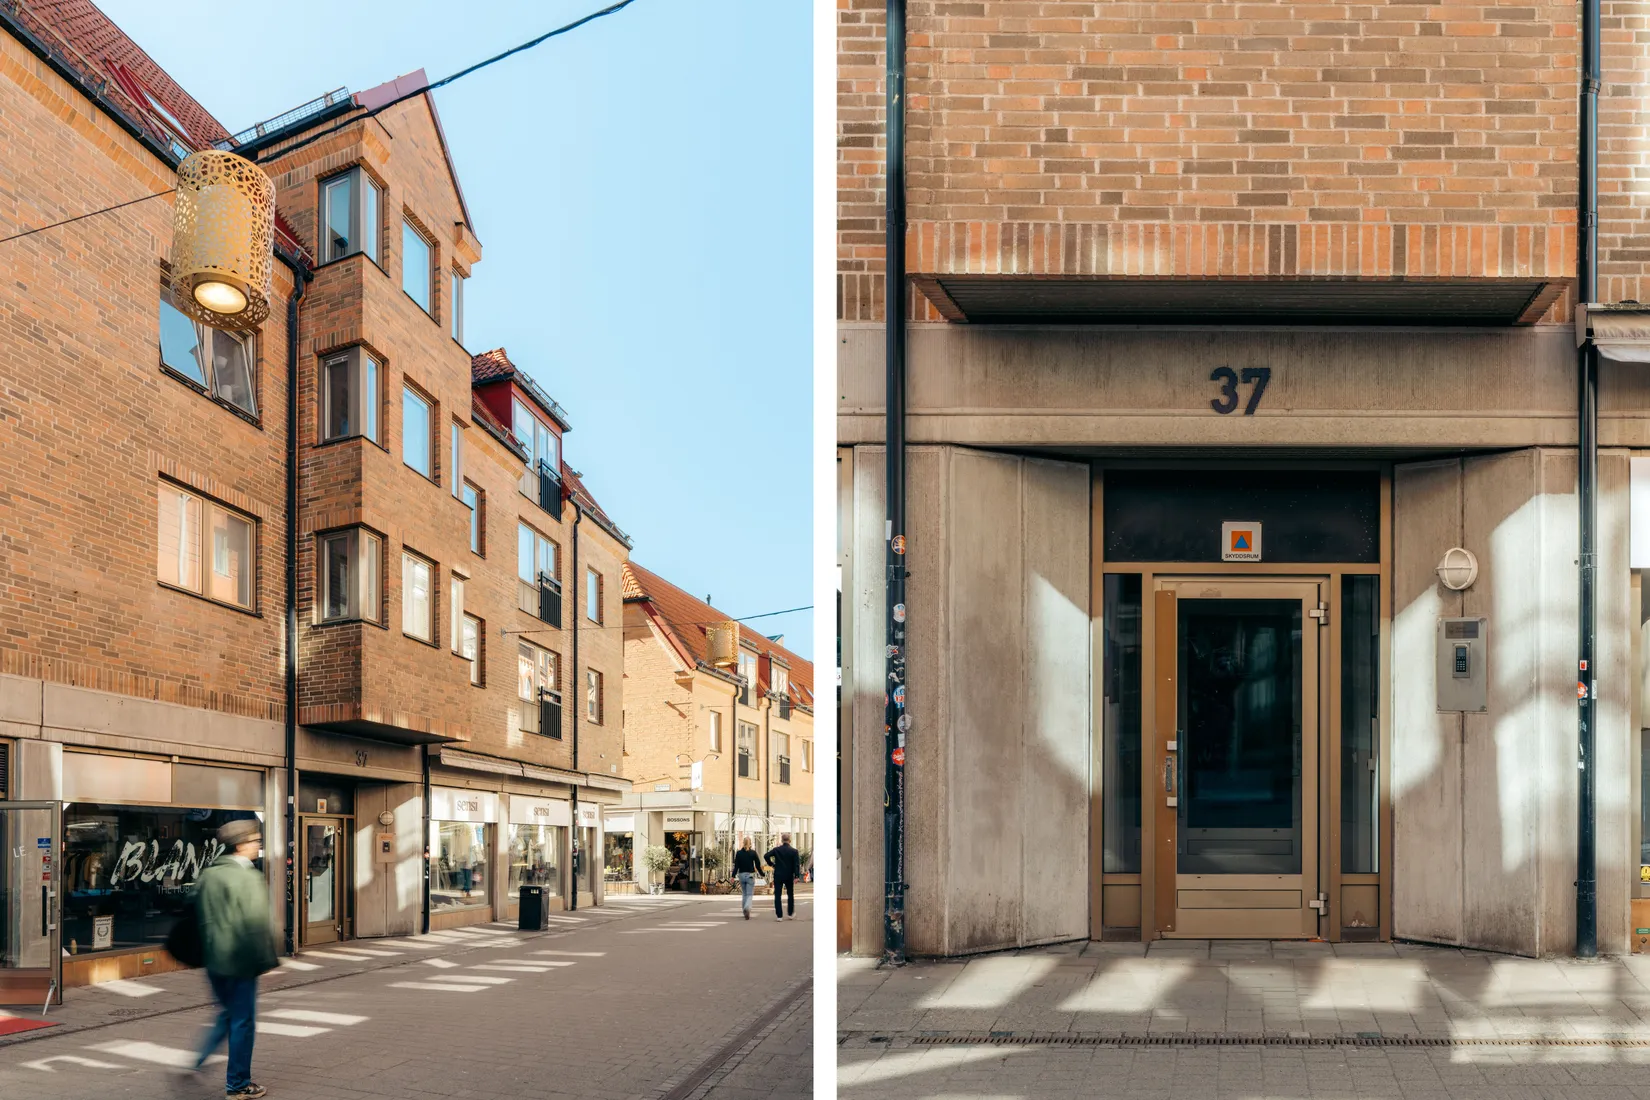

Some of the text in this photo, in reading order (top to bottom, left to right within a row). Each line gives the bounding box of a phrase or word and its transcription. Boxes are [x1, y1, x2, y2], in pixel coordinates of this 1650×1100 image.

[1209, 366, 1271, 415] 37
[355, 750, 368, 767] 37
[456, 796, 479, 812] sensi
[533, 803, 550, 817] sensi
[582, 807, 596, 819] sensi
